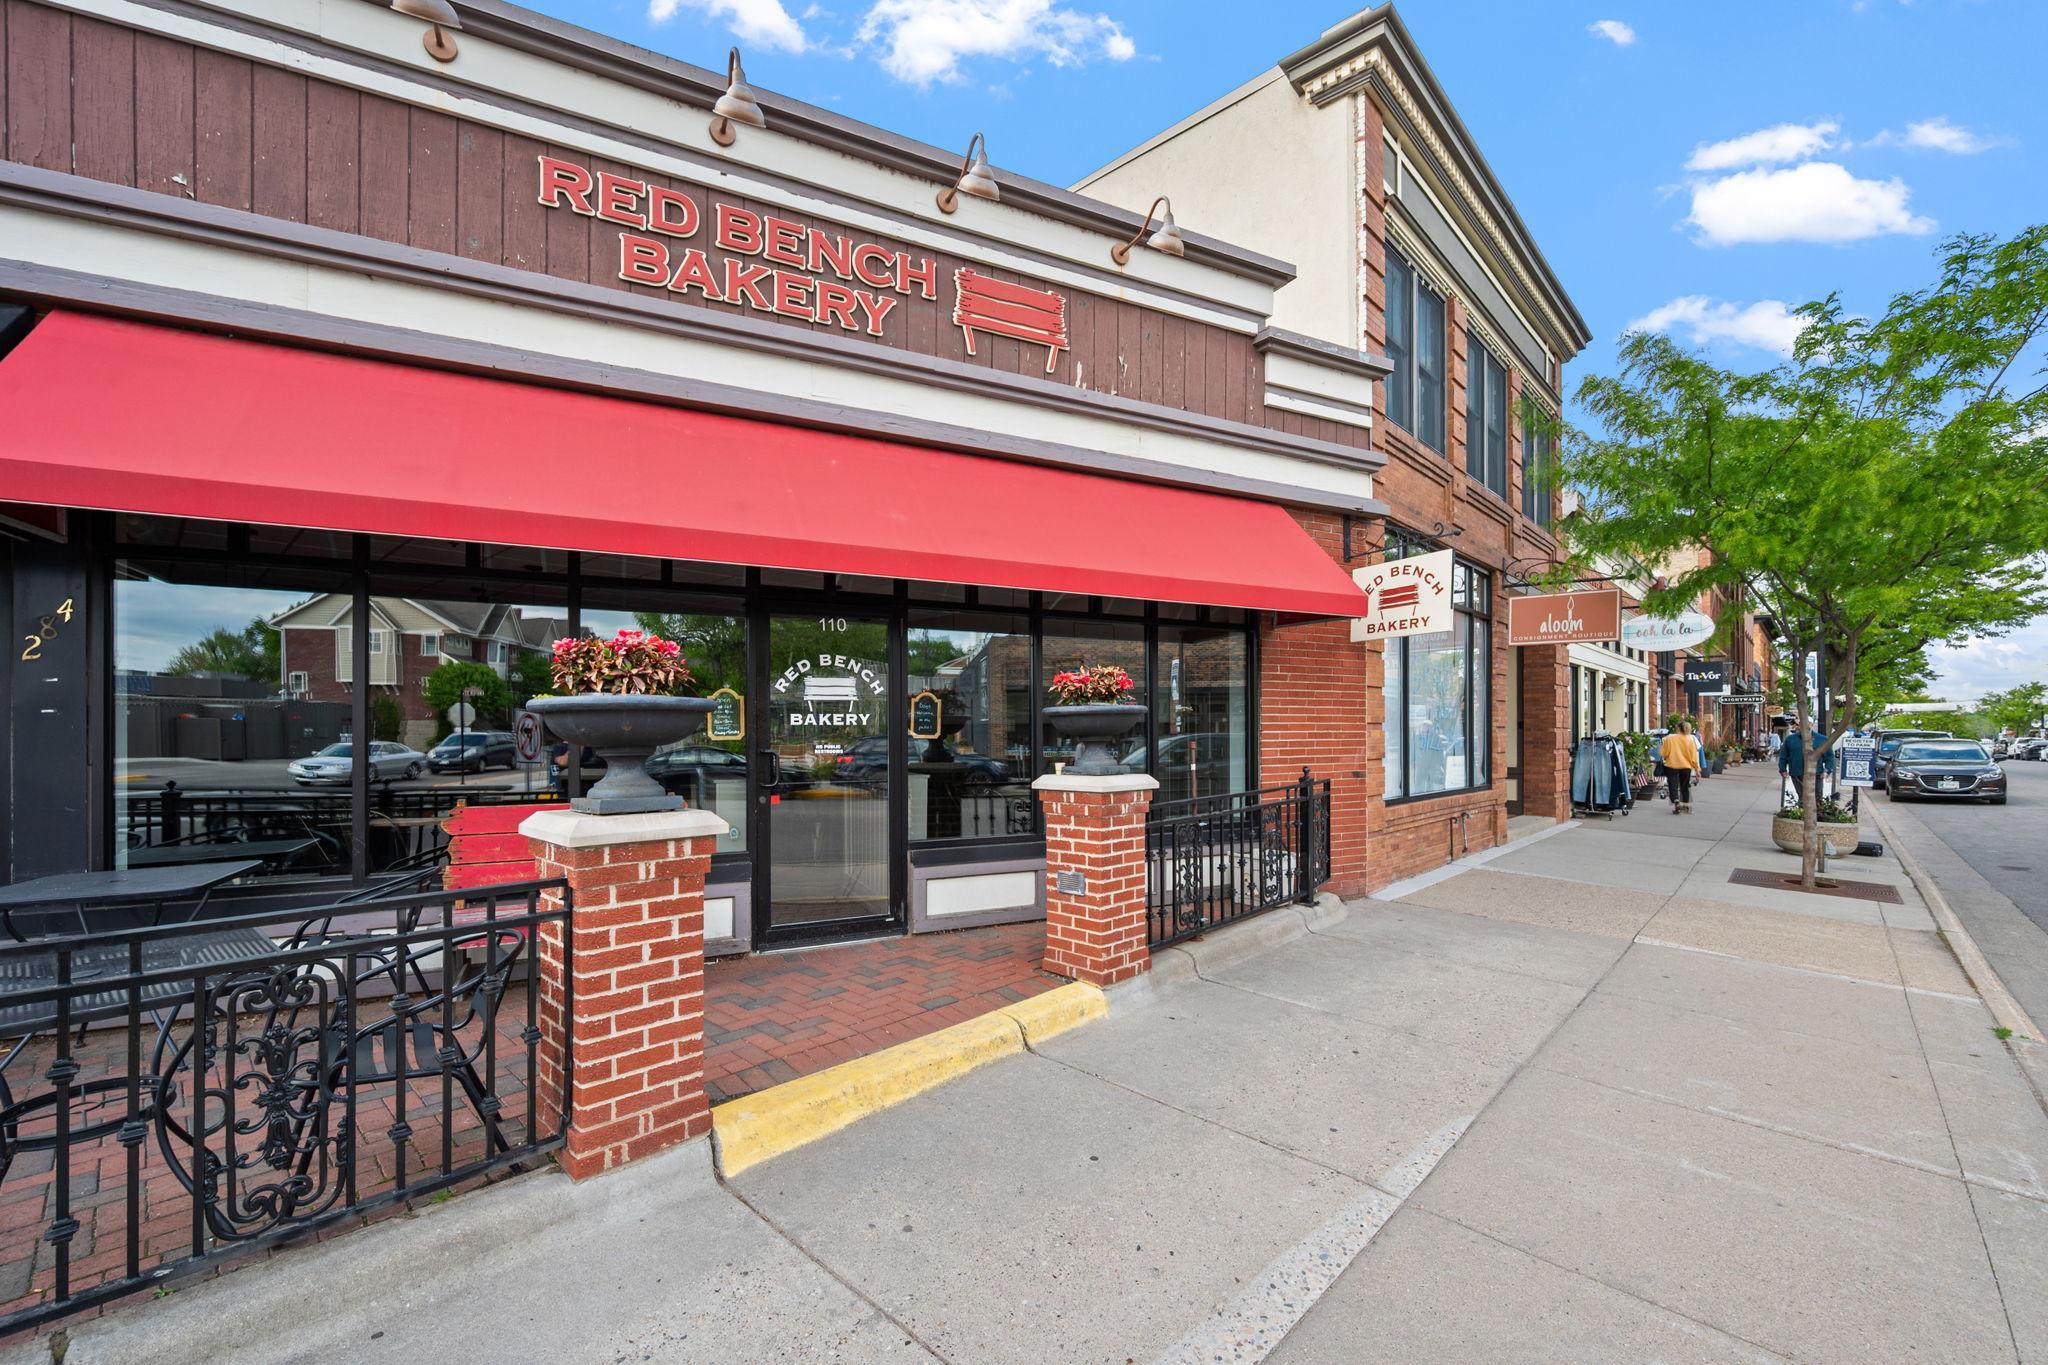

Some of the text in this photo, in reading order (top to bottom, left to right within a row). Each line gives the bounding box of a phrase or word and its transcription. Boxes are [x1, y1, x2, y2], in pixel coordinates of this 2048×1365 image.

[537, 154, 937, 300] RED BENCH
[618, 233, 897, 337] BAKERY
[1390, 564, 1444, 596] BENCH
[819, 617, 847, 632] 110
[1367, 616, 1431, 634] BAKERY
[1539, 612, 1584, 635] aloom
[1635, 622, 1694, 638] ooh la la
[1572, 631, 1614, 639] BOUTIQUE
[774, 654, 885, 695] RED BENCH
[790, 713, 870, 726] BAKERY
